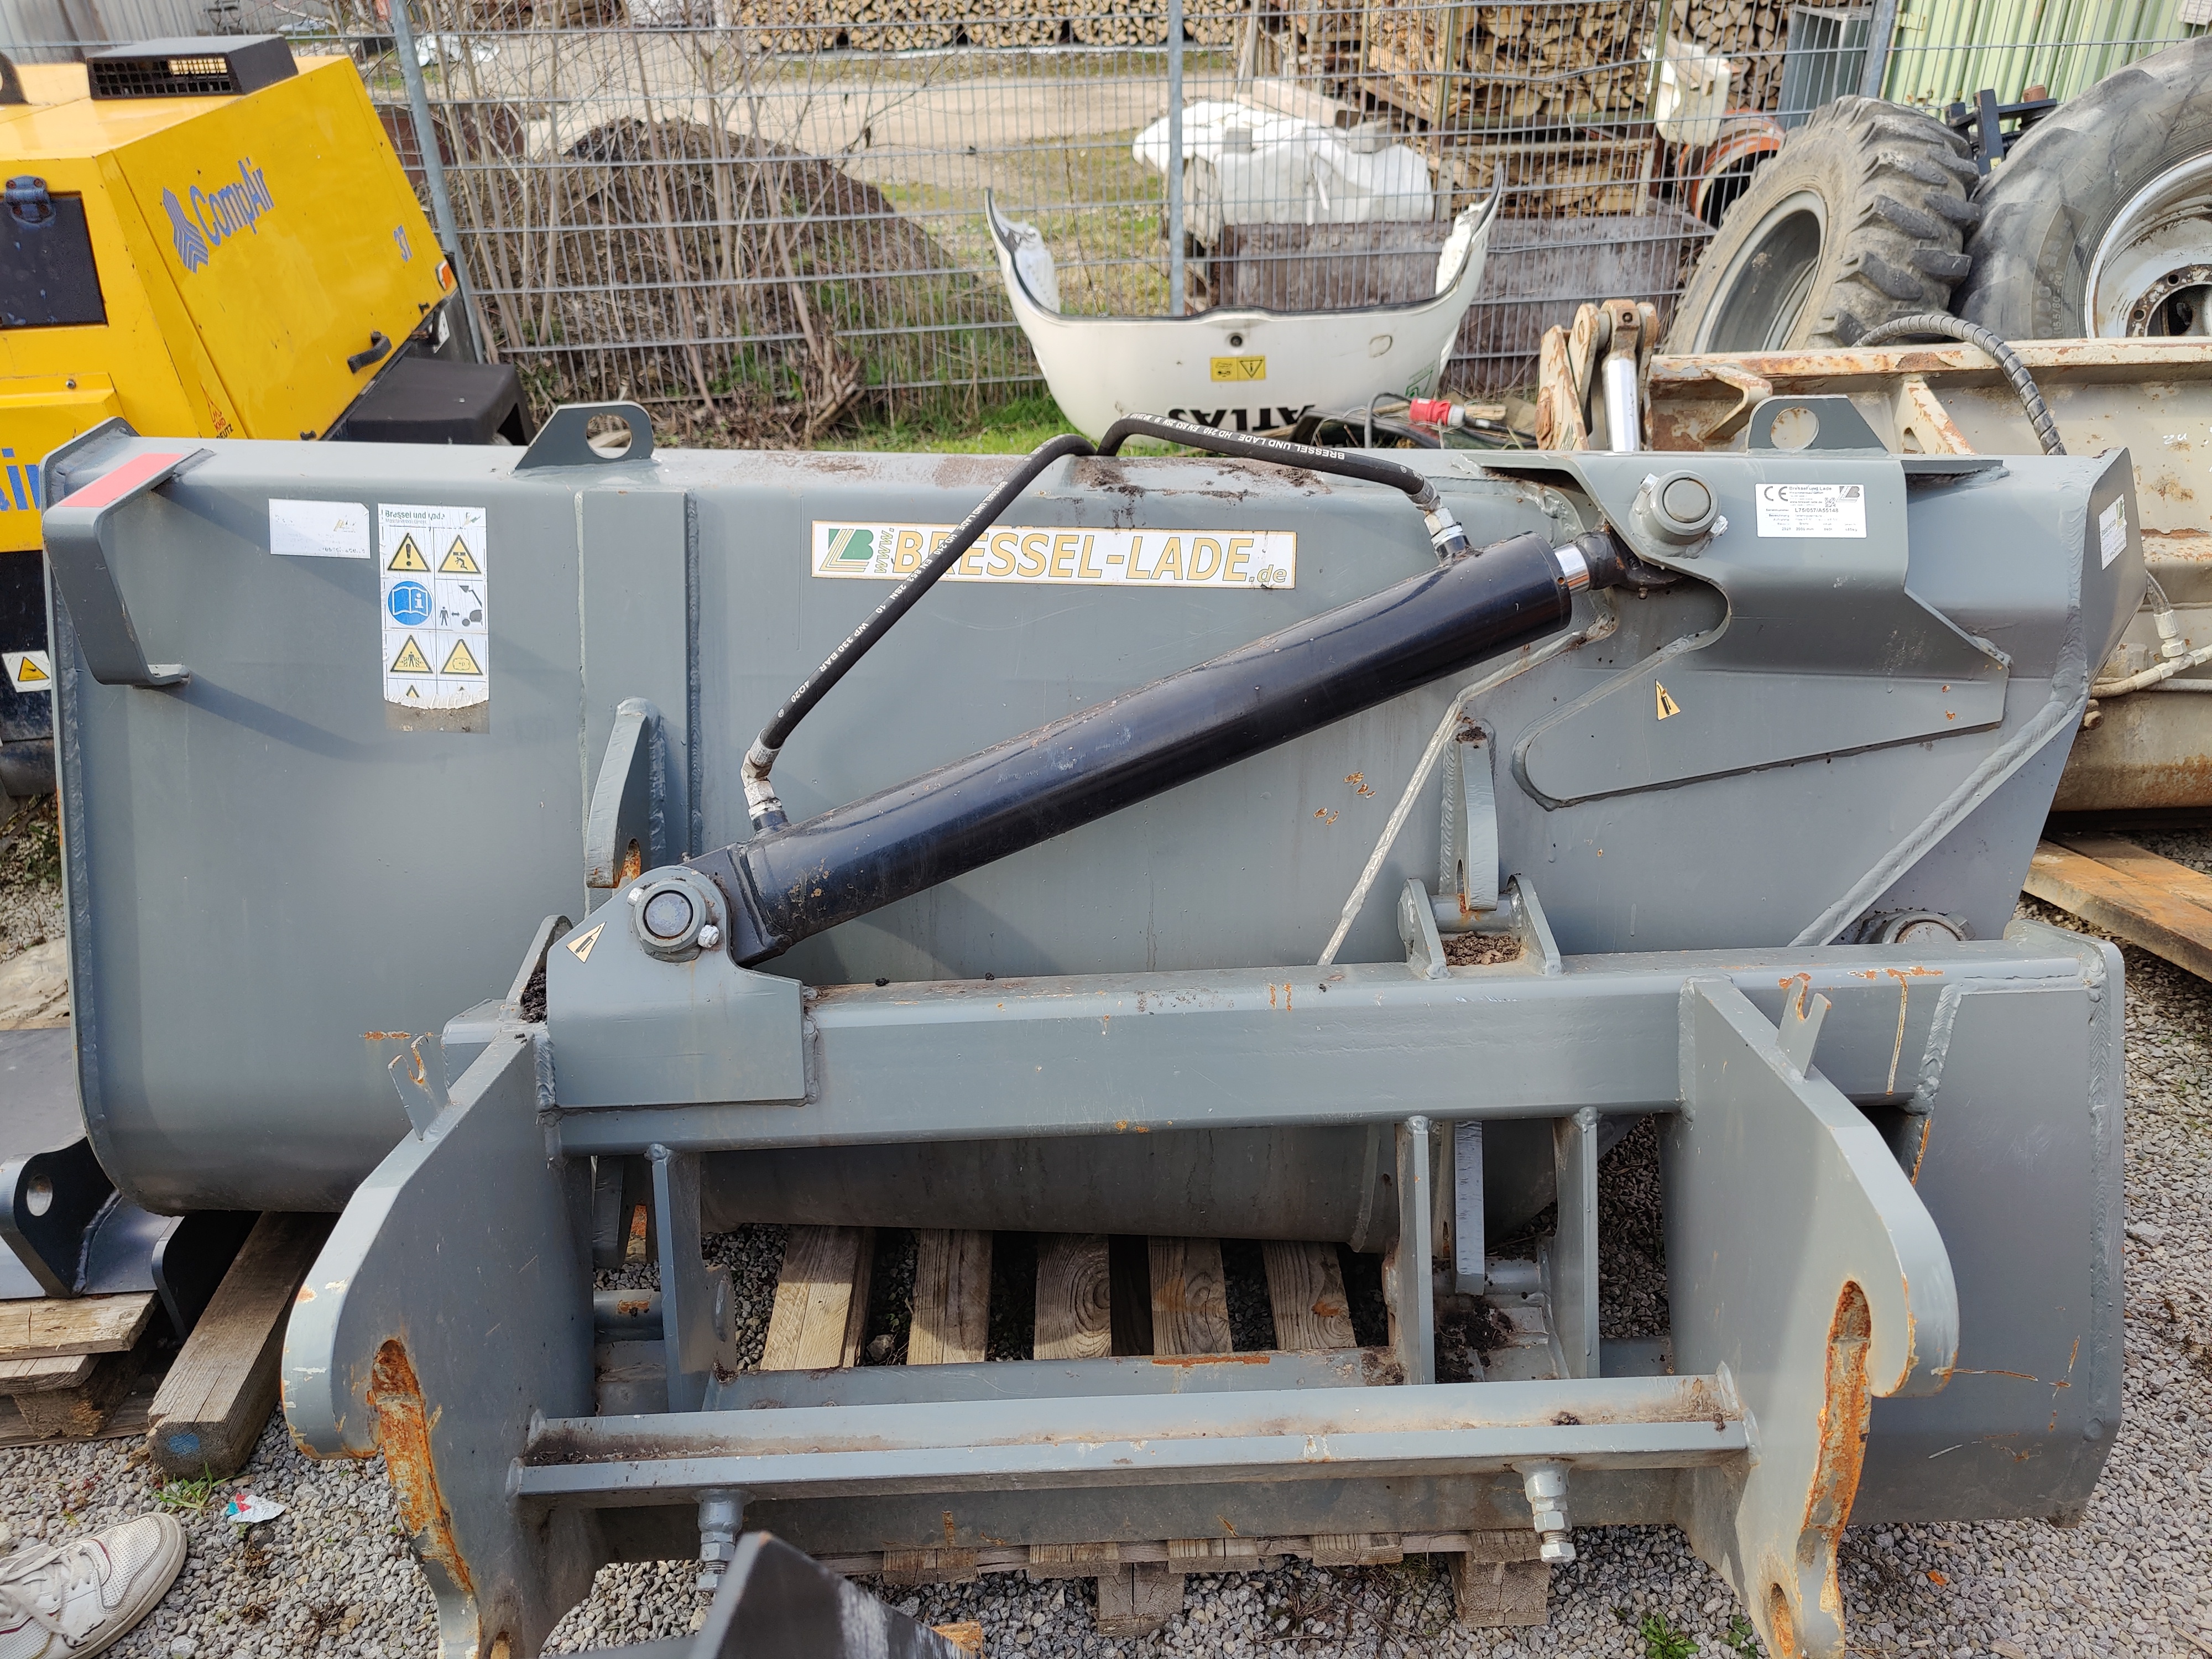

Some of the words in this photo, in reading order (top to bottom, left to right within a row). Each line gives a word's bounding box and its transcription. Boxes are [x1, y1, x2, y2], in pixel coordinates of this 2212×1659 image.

[190, 156, 274, 246] CompAir
[393, 225, 413, 263] 37
[1218, 430, 1233, 439] HD
[1238, 434, 1266, 445] LADE
[1268, 439, 1291, 451] UND
[1295, 445, 1345, 460] BRESSEL
[982, 481, 1008, 502] BRESSEL
[972, 503, 987, 515] UND
[957, 514, 976, 531] LADE
[945, 534, 957, 544] HD
[933, 544, 947, 555] 210
[919, 559, 932, 570] EN
[906, 570, 921, 582] 853
[889, 583, 907, 600] 2SN
[875, 604, 886, 614] 10
[854, 622, 869, 637] WP
[837, 637, 853, 653] 330
[818, 651, 838, 672] BAR
